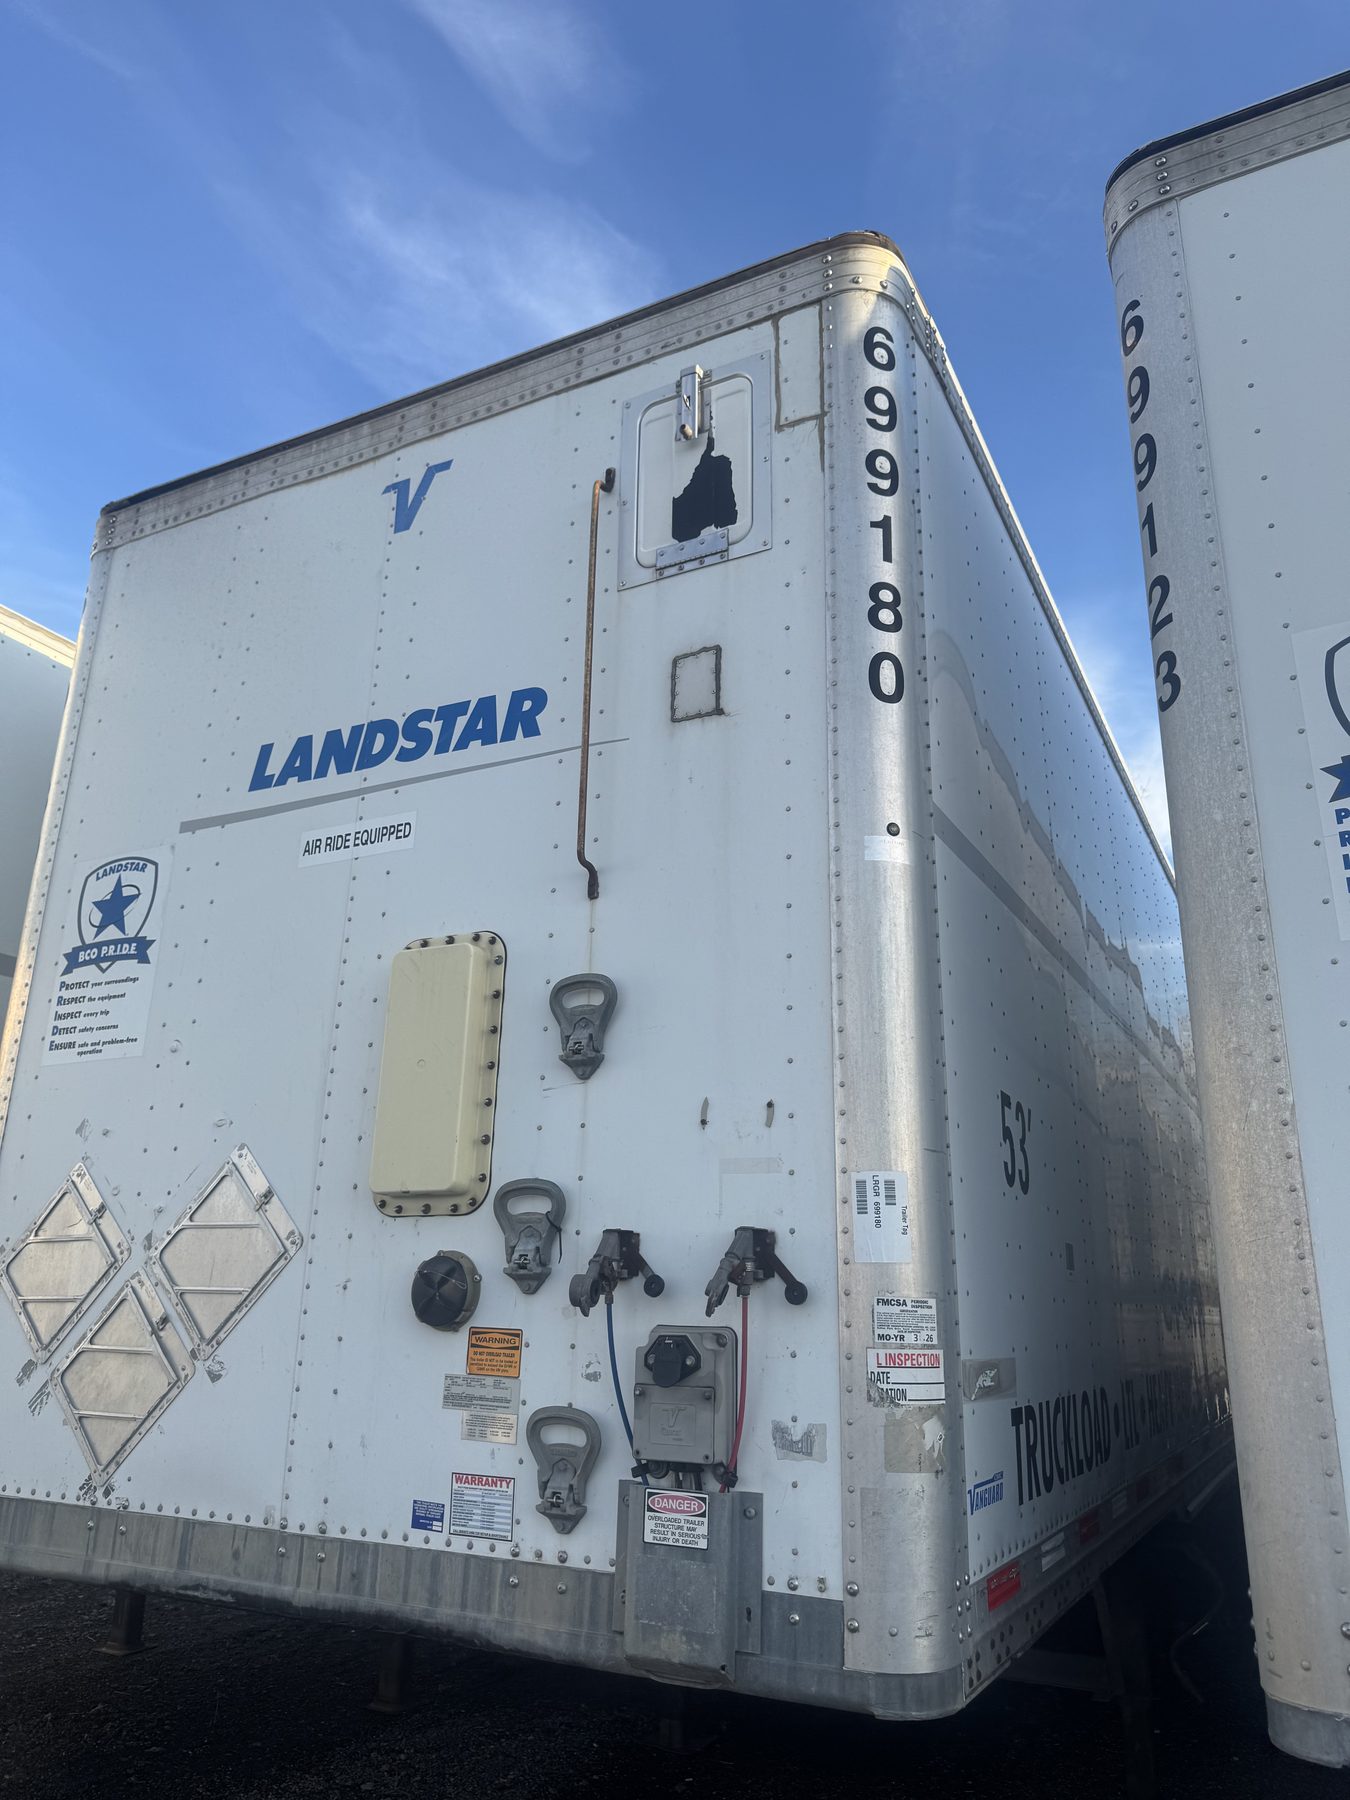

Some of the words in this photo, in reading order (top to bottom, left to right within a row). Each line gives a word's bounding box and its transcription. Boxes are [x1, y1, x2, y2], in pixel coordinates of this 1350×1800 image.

[1121, 298, 1182, 713] 699123
[863, 326, 905, 704] 699180
[248, 686, 548, 792] LANDSTAR
[302, 838, 322, 857] AIR
[324, 832, 352, 853] RIDE
[353, 821, 412, 848] EQUIPPED
[95, 861, 148, 882] LANDSTAR
[78, 949, 98, 962] BCO
[59, 980, 90, 991] PROTECT
[104, 976, 139, 986] surroundings
[56, 995, 86, 1006] RESPECT
[97, 992, 126, 1003] equipment
[54, 1010, 82, 1021] INSPECT
[51, 1025, 77, 1036] DETECT
[48, 1040, 76, 1051] ENSURE
[101, 1037, 138, 1047] problem-free
[77, 1048, 102, 1057] operation
[873, 1201, 882, 1229] 699180
[900, 1205, 908, 1224] Trailer
[876, 1298, 908, 1307] FMCSA
[474, 1336, 517, 1345] WARNING
[877, 1333, 905, 1342] MO-YR
[885, 1353, 940, 1366] INSPECTION
[870, 1371, 891, 1385] DATE
[1010, 1383, 1111, 1506] TRUCKLOAD
[454, 1474, 512, 1489] WARRANTY
[654, 1497, 698, 1511] DANGER
[967, 1481, 1004, 1515] VANGUARD
[648, 1515, 682, 1525] OVERLOADED
[683, 1518, 705, 1527] TRAILER
[654, 1523, 684, 1531] STRUCTURE
[678, 1532, 702, 1540] SERIOUS
